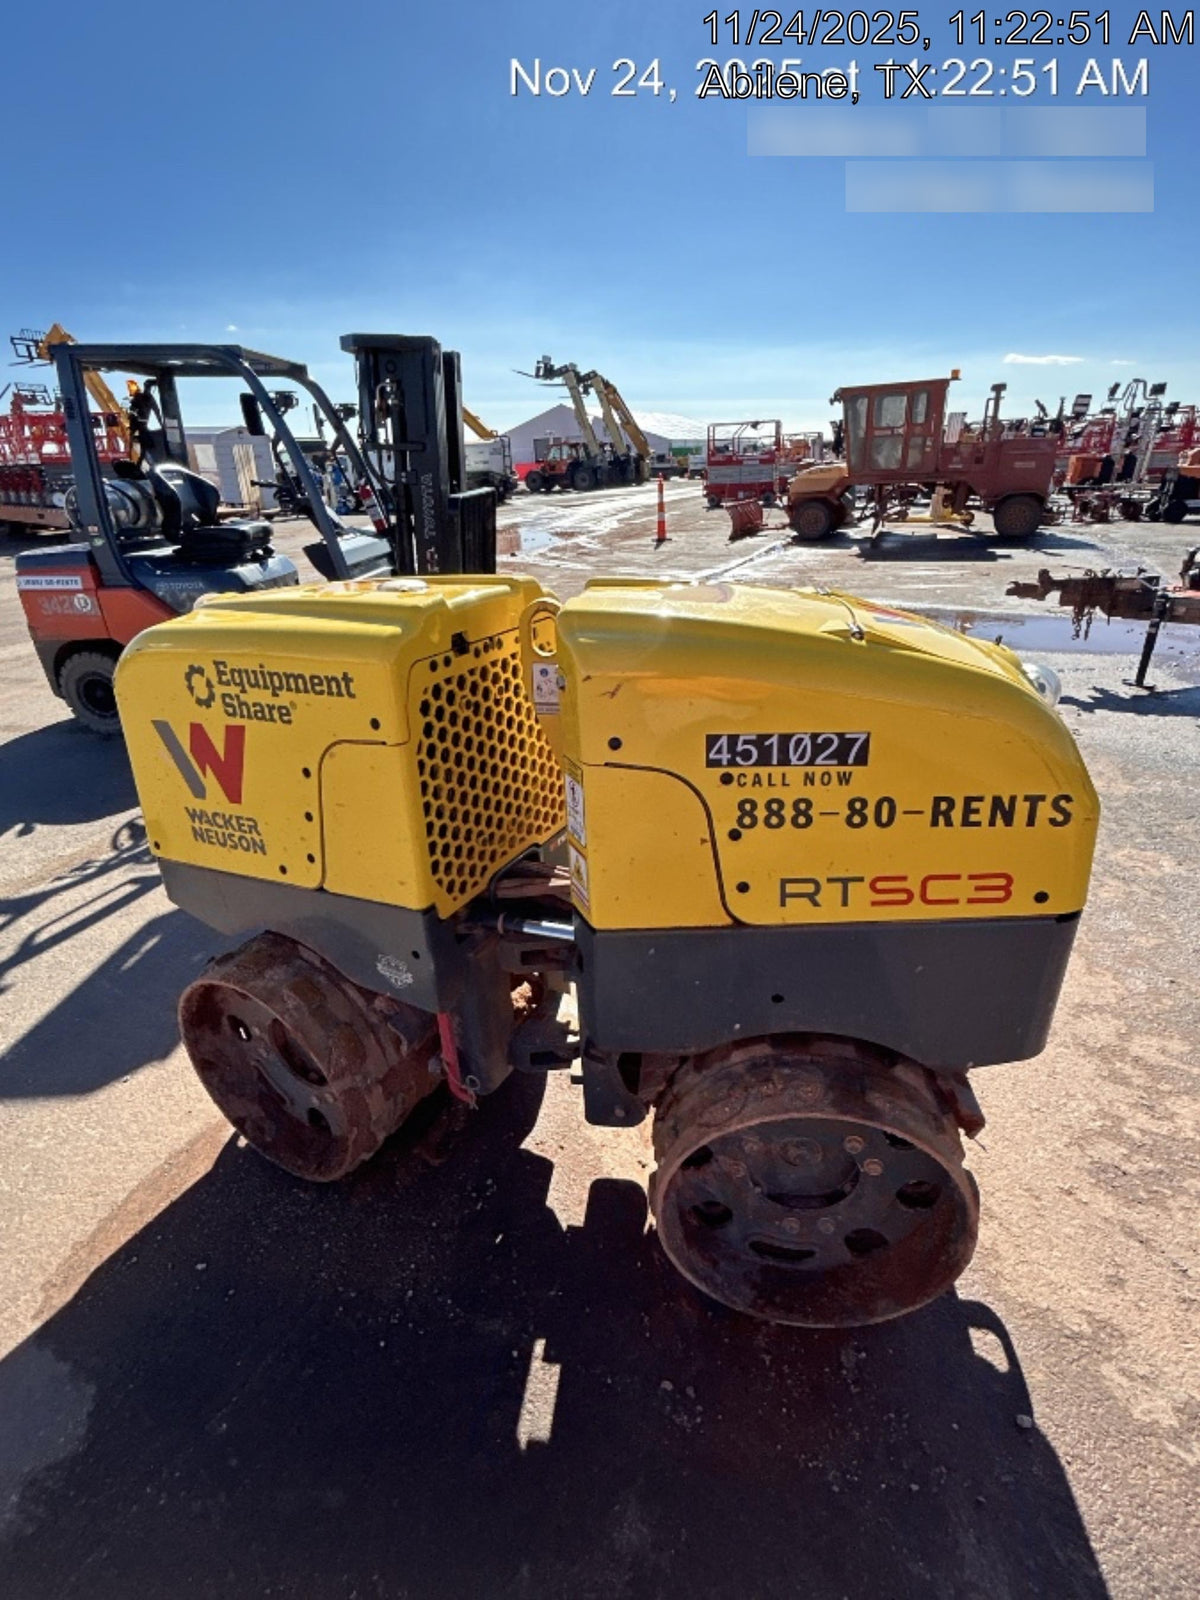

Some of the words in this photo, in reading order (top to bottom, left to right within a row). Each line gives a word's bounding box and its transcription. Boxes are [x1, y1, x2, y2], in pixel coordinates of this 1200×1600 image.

[213, 659, 356, 699] Equipment
[708, 732, 870, 767] 451027
[736, 772, 791, 788] CALL
[803, 770, 854, 787] NOW
[184, 805, 262, 837] WACKER
[736, 794, 1074, 830] 888-80-RENTS
[191, 825, 267, 857] NEUSON
